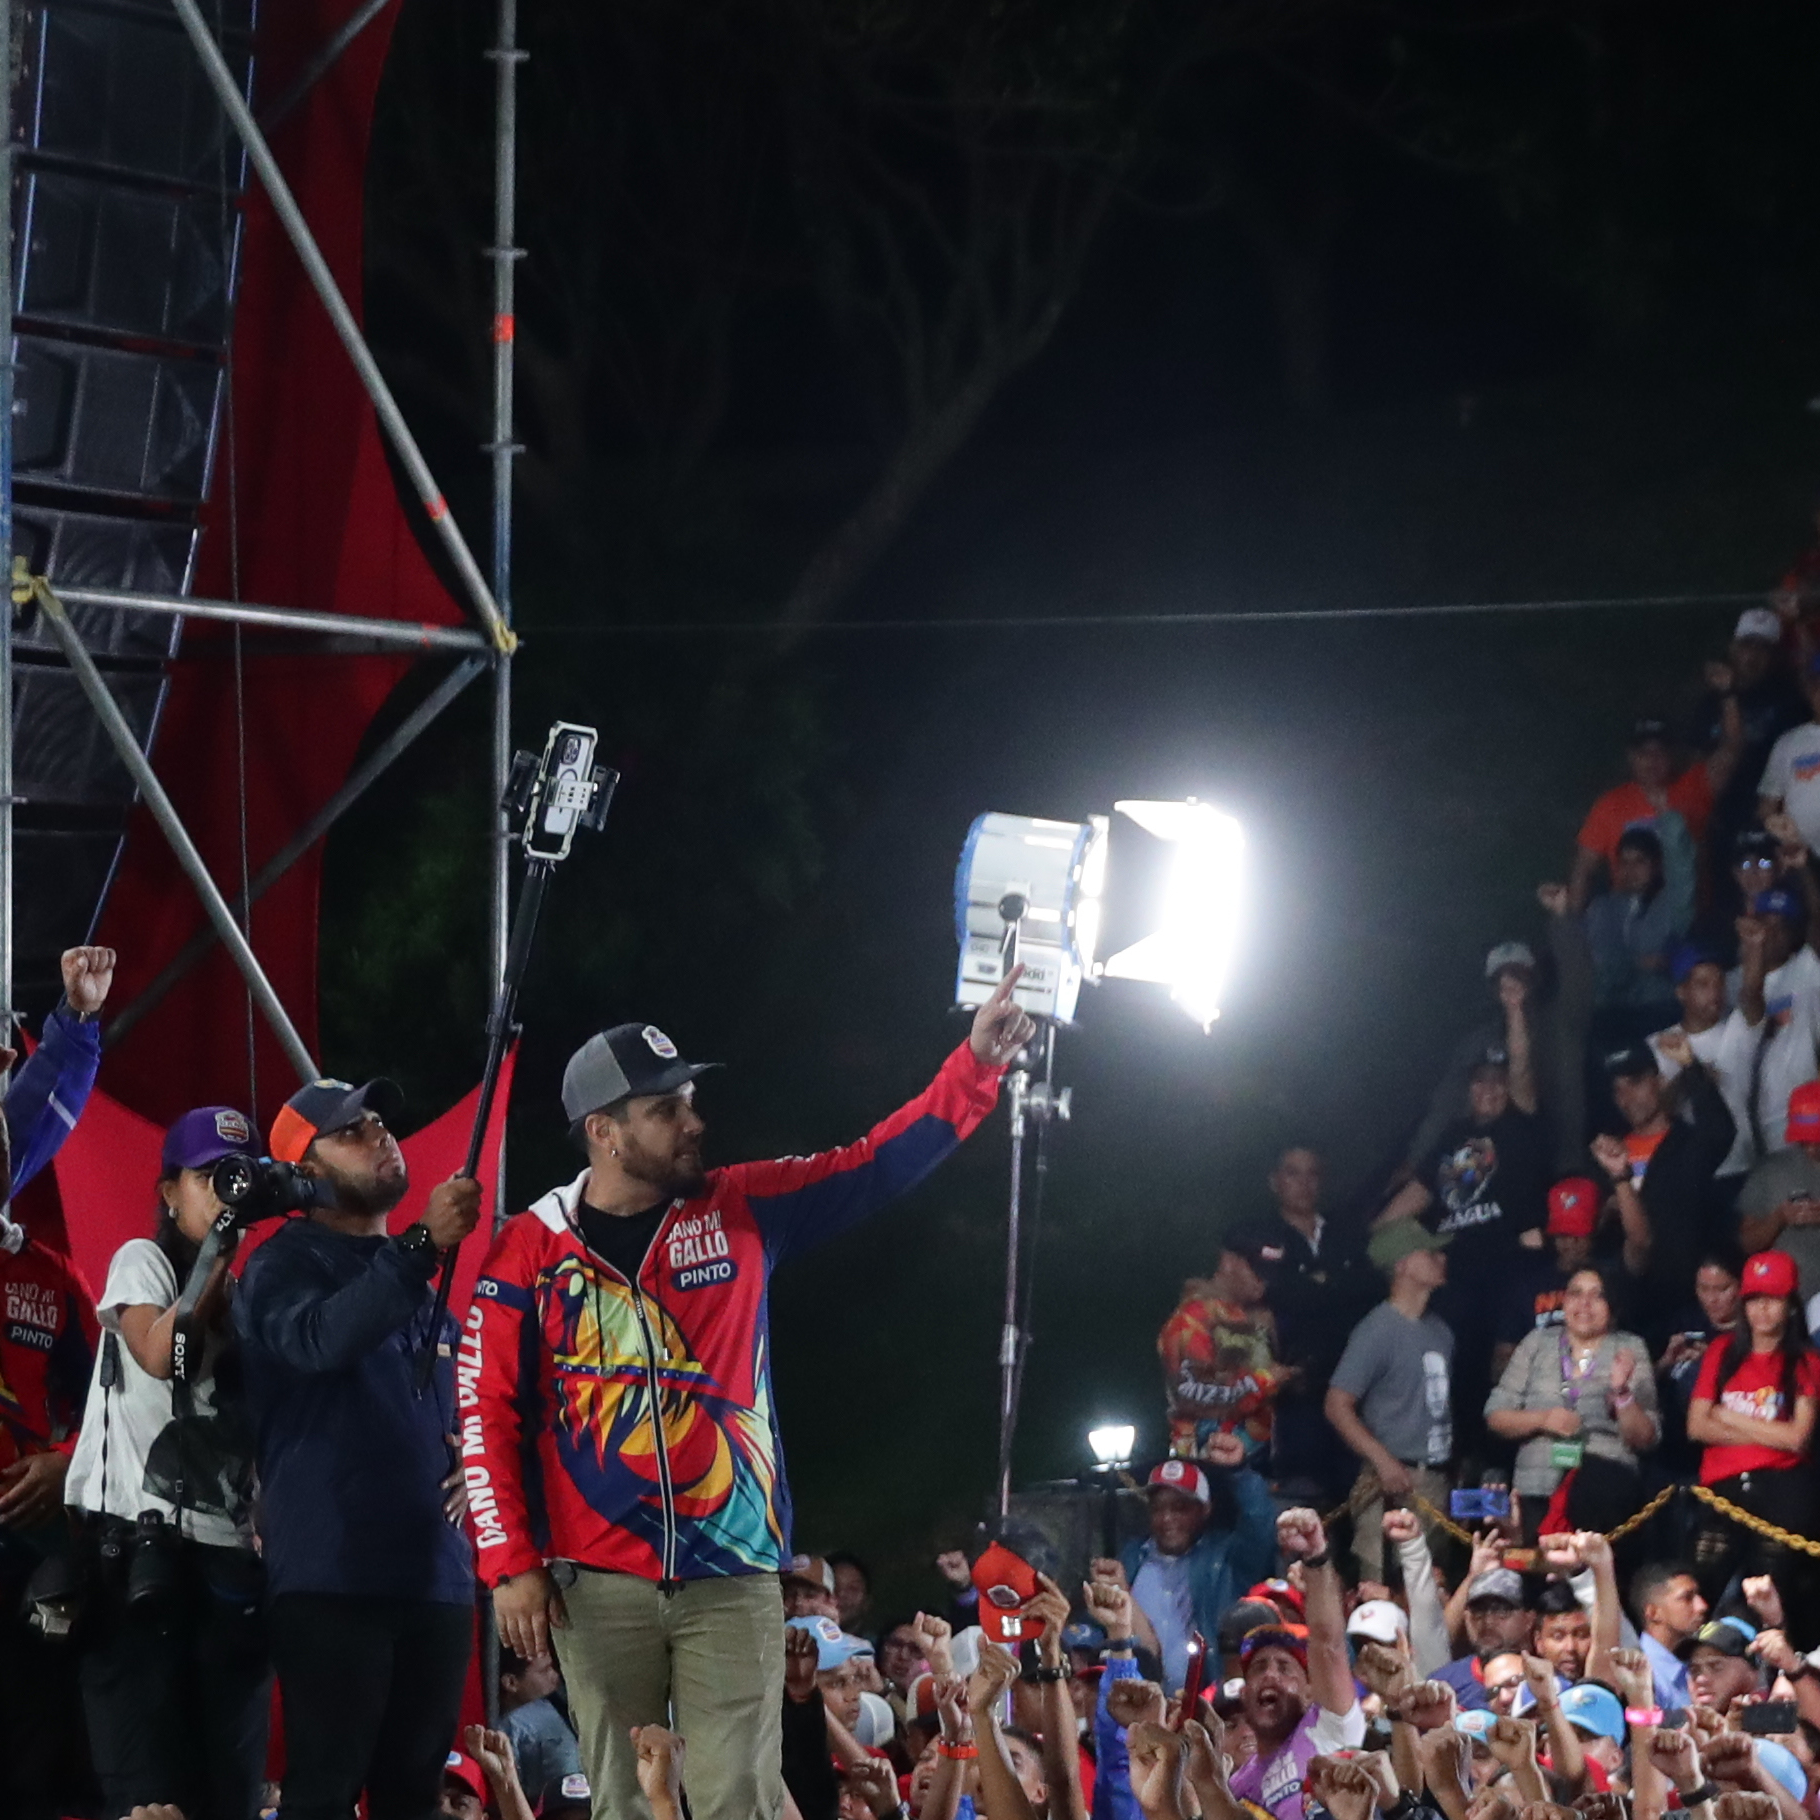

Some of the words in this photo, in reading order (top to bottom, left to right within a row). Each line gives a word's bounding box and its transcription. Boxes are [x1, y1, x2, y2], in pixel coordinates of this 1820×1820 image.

[669, 1231, 729, 1269] GALLO
[680, 1262, 731, 1287] PINTO
[6, 1296, 58, 1329] GALLO
[11, 1326, 53, 1348] PINTO
